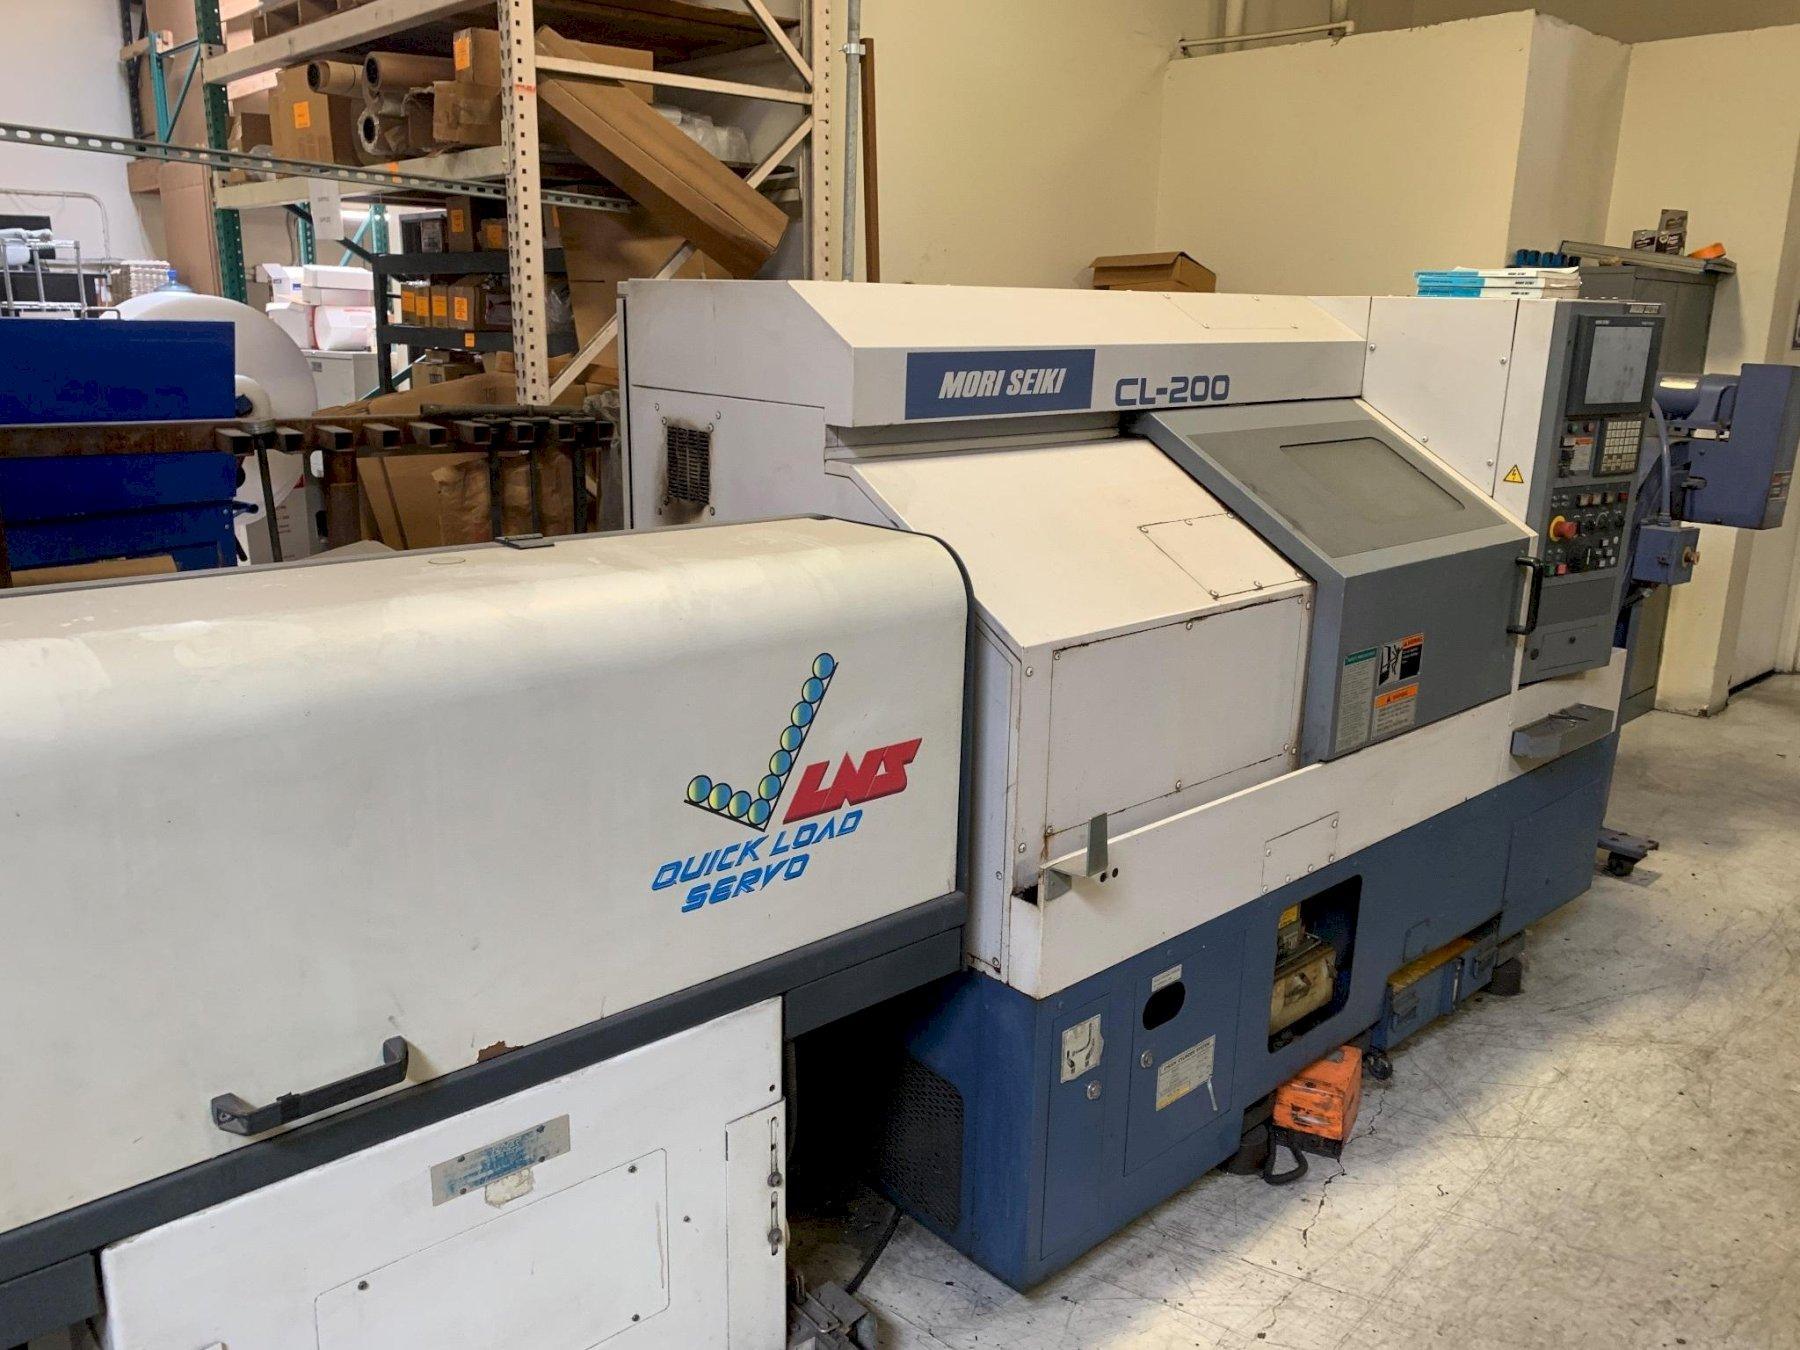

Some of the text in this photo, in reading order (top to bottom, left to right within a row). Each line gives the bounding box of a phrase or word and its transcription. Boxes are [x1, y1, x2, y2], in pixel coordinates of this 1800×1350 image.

[938, 367, 1067, 399] MORI SEIKI
[1115, 374, 1230, 407] CL-200
[783, 737, 922, 825] LNS
[651, 809, 863, 891] QUICK LOAD
[681, 853, 810, 913] SERVO
